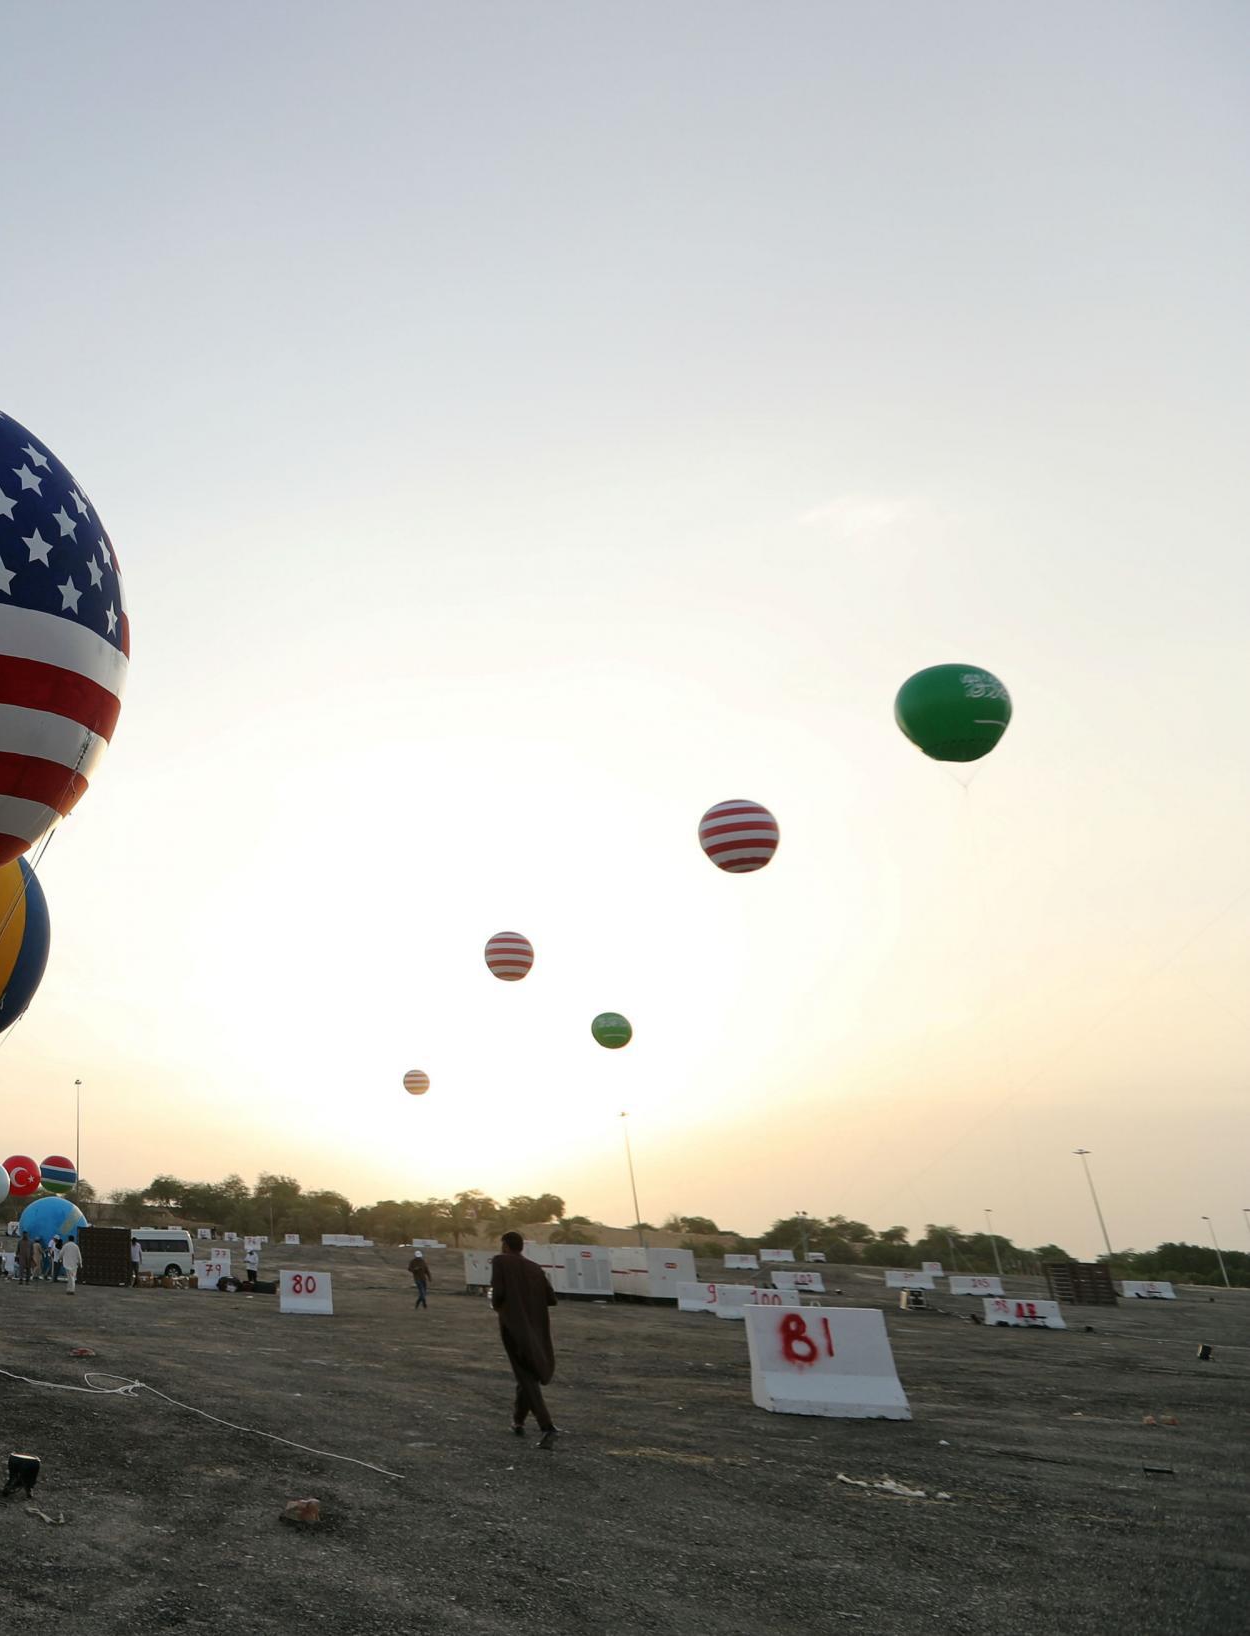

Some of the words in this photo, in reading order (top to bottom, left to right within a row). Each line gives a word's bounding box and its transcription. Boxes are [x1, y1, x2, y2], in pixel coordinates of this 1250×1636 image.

[205, 1263, 222, 1277] 79
[291, 1274, 317, 1294] 80
[781, 1313, 835, 1363] 81
